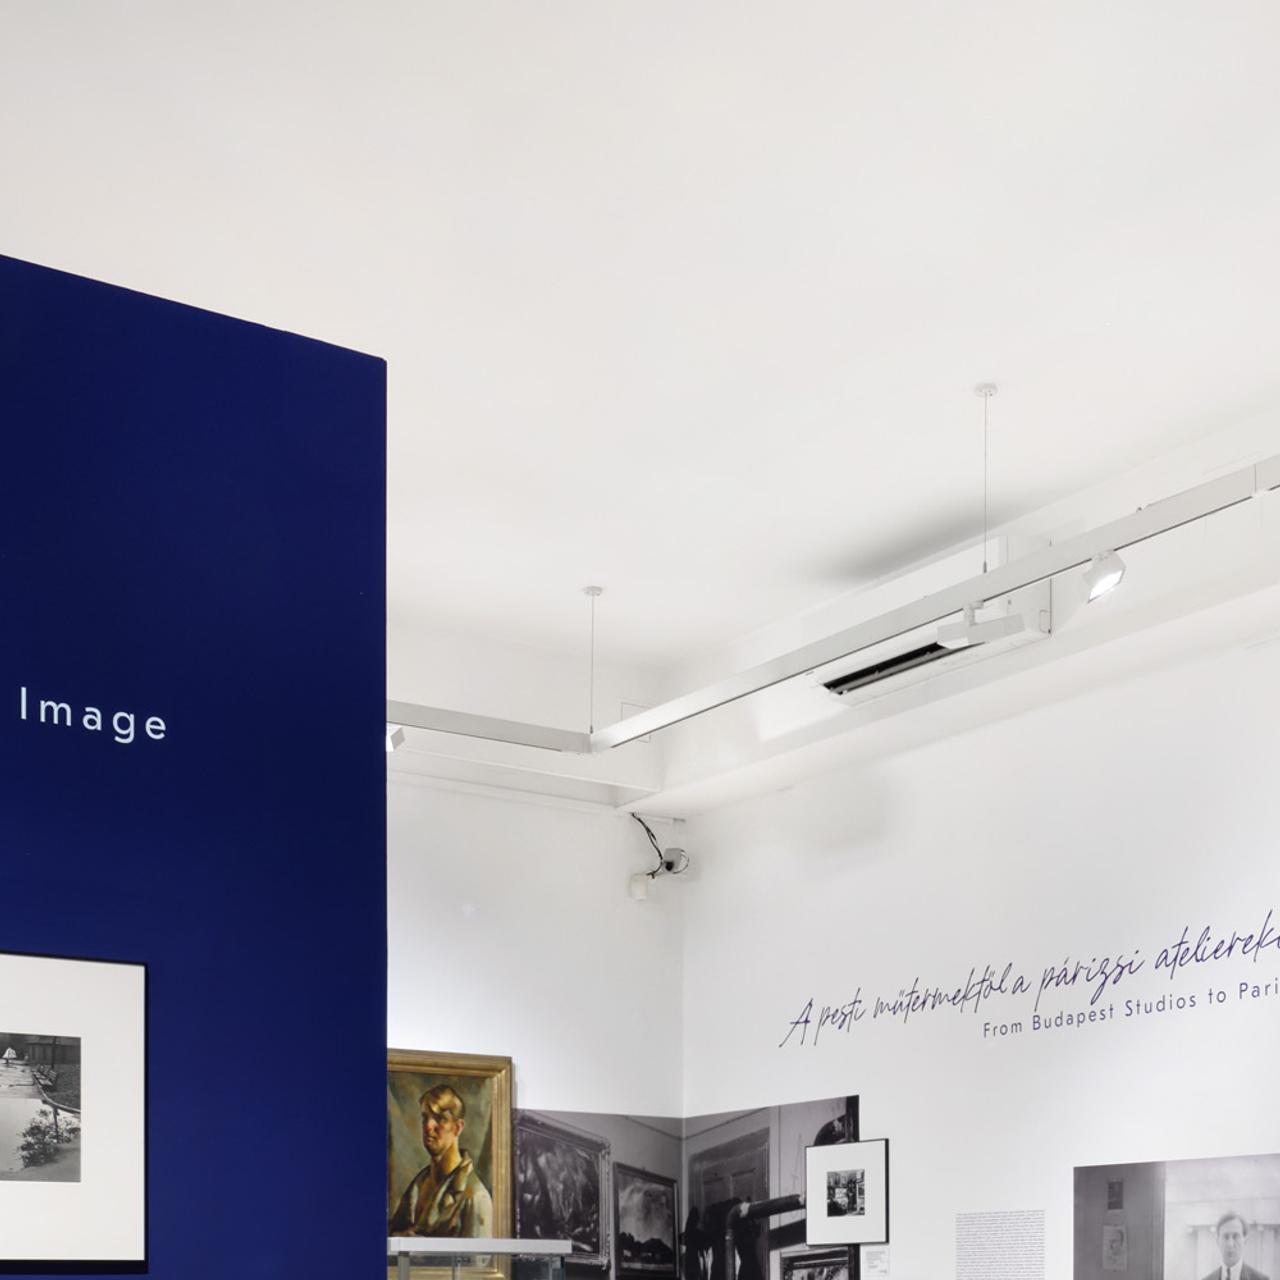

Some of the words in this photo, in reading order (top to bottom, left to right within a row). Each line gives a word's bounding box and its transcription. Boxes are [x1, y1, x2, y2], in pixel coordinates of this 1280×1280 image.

[22, 687, 165, 743] Image
[779, 998, 813, 1047] A
[814, 987, 866, 1046] pesti
[1033, 949, 1145, 1013] párizsi
[983, 1021, 1022, 1038] From
[1032, 1004, 1114, 1031] Budapest
[1124, 993, 1197, 1017] Studios
[1207, 988, 1227, 1004] to
